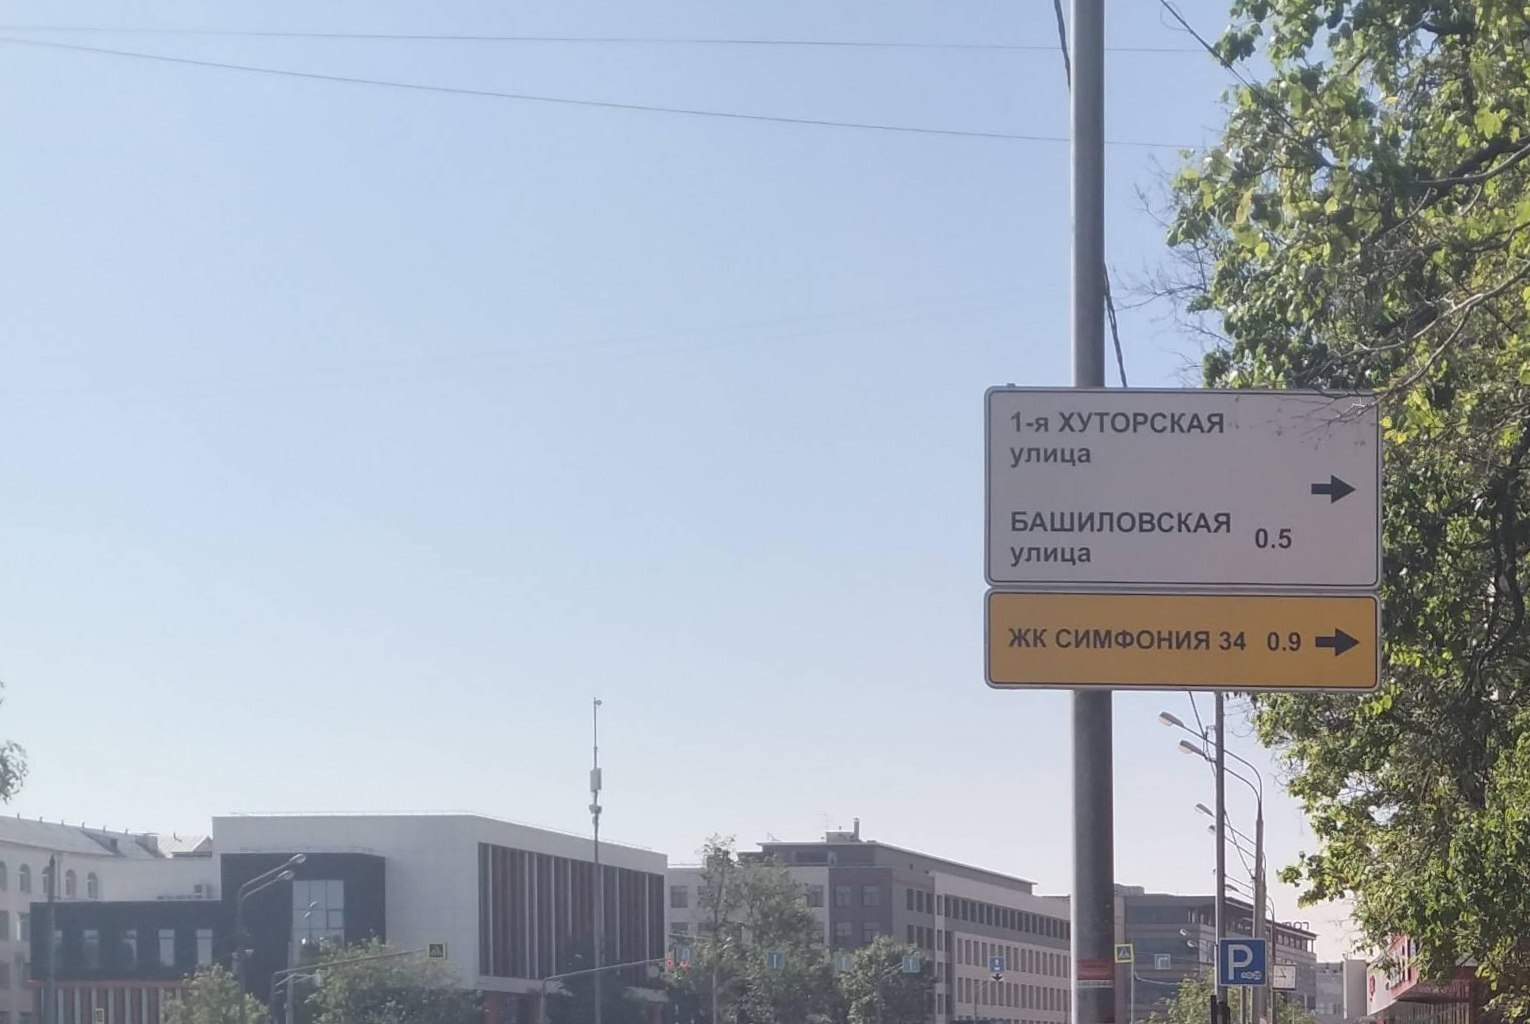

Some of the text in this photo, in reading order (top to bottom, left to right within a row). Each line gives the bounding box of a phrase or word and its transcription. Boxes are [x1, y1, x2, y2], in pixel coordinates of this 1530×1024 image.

[1010, 411, 1225, 434] 1-я ХУТОРСКАЯ
[1010, 445, 1092, 467] улица
[1010, 511, 1232, 534] БАШИЛОВСКАЯ
[1254, 528, 1292, 549] 0.5
[1010, 544, 1092, 567] улица
[1008, 629, 1302, 652] ЖК СИМФОНИЯ 34 0.9
